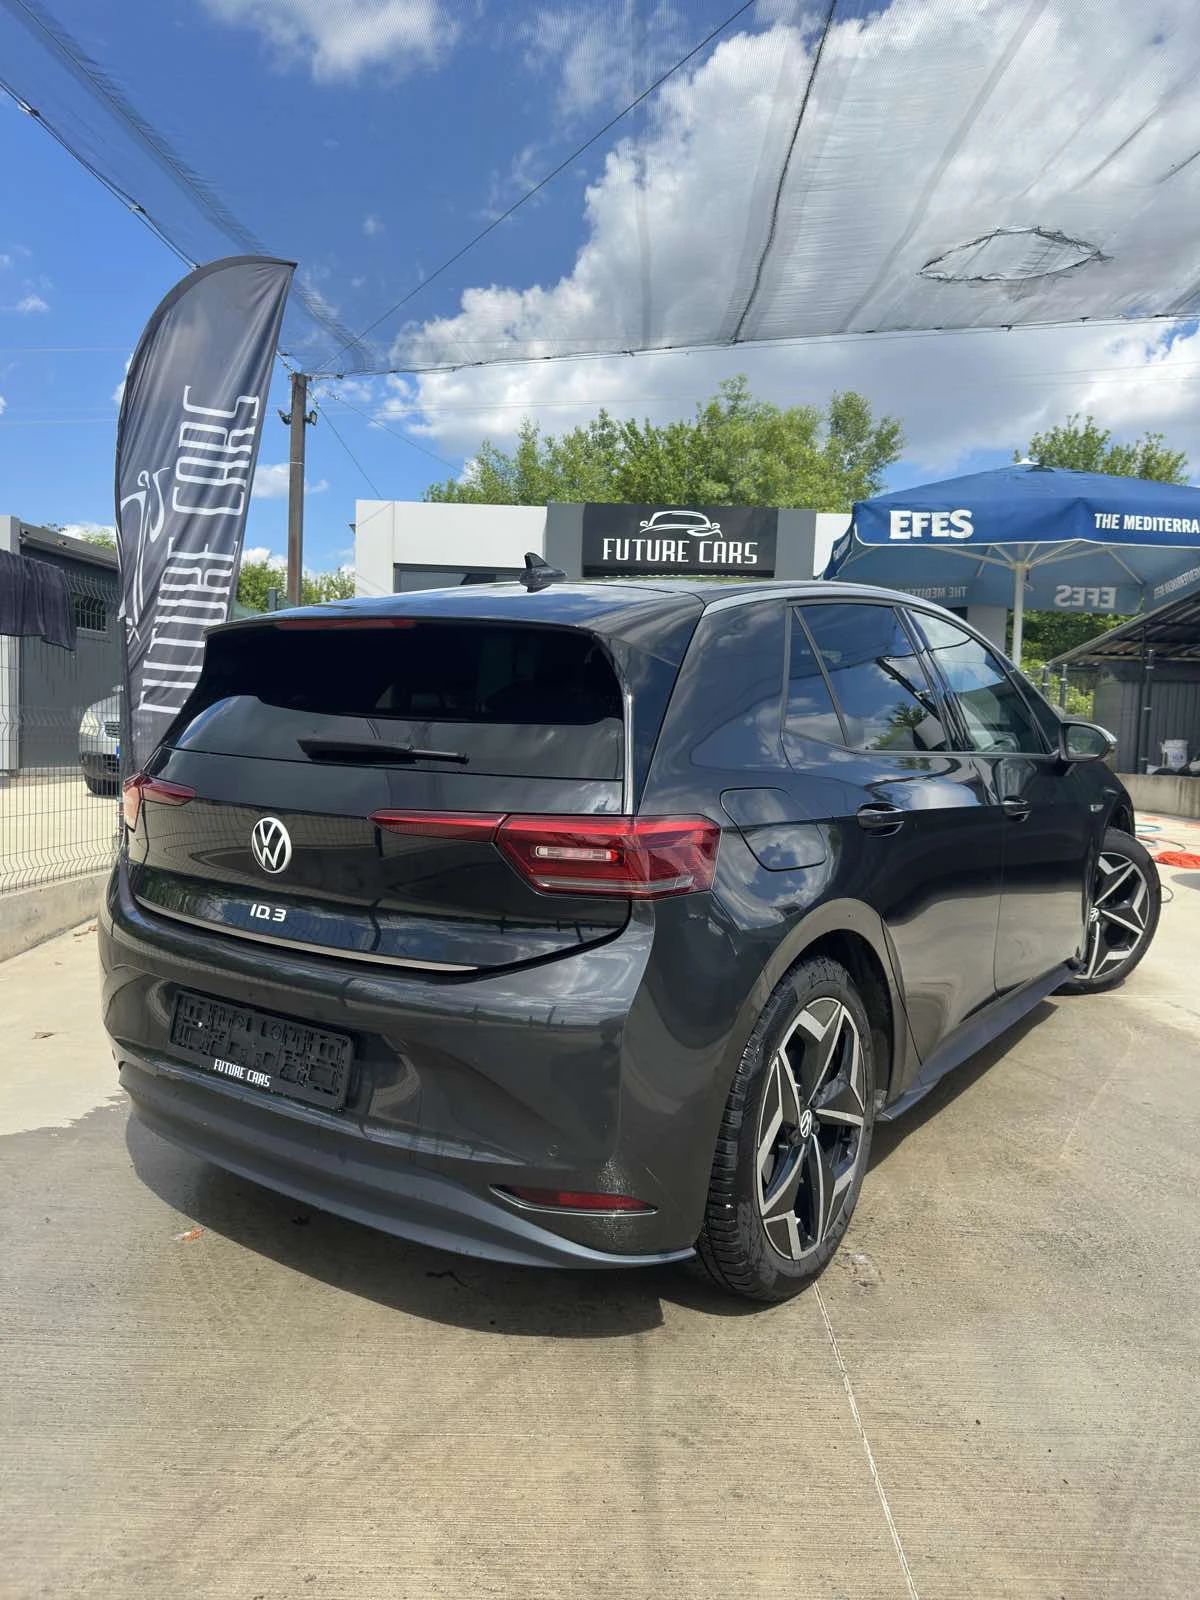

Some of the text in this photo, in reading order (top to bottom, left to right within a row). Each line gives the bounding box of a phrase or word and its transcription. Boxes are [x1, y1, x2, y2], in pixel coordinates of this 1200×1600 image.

[172, 385, 260, 516] CARS
[889, 509, 974, 539] EFES
[1094, 513, 1200, 534] THE MEDITERRA
[602, 538, 759, 564] FUTURE CARS
[213, 1058, 272, 1087] FUTURE CARS
